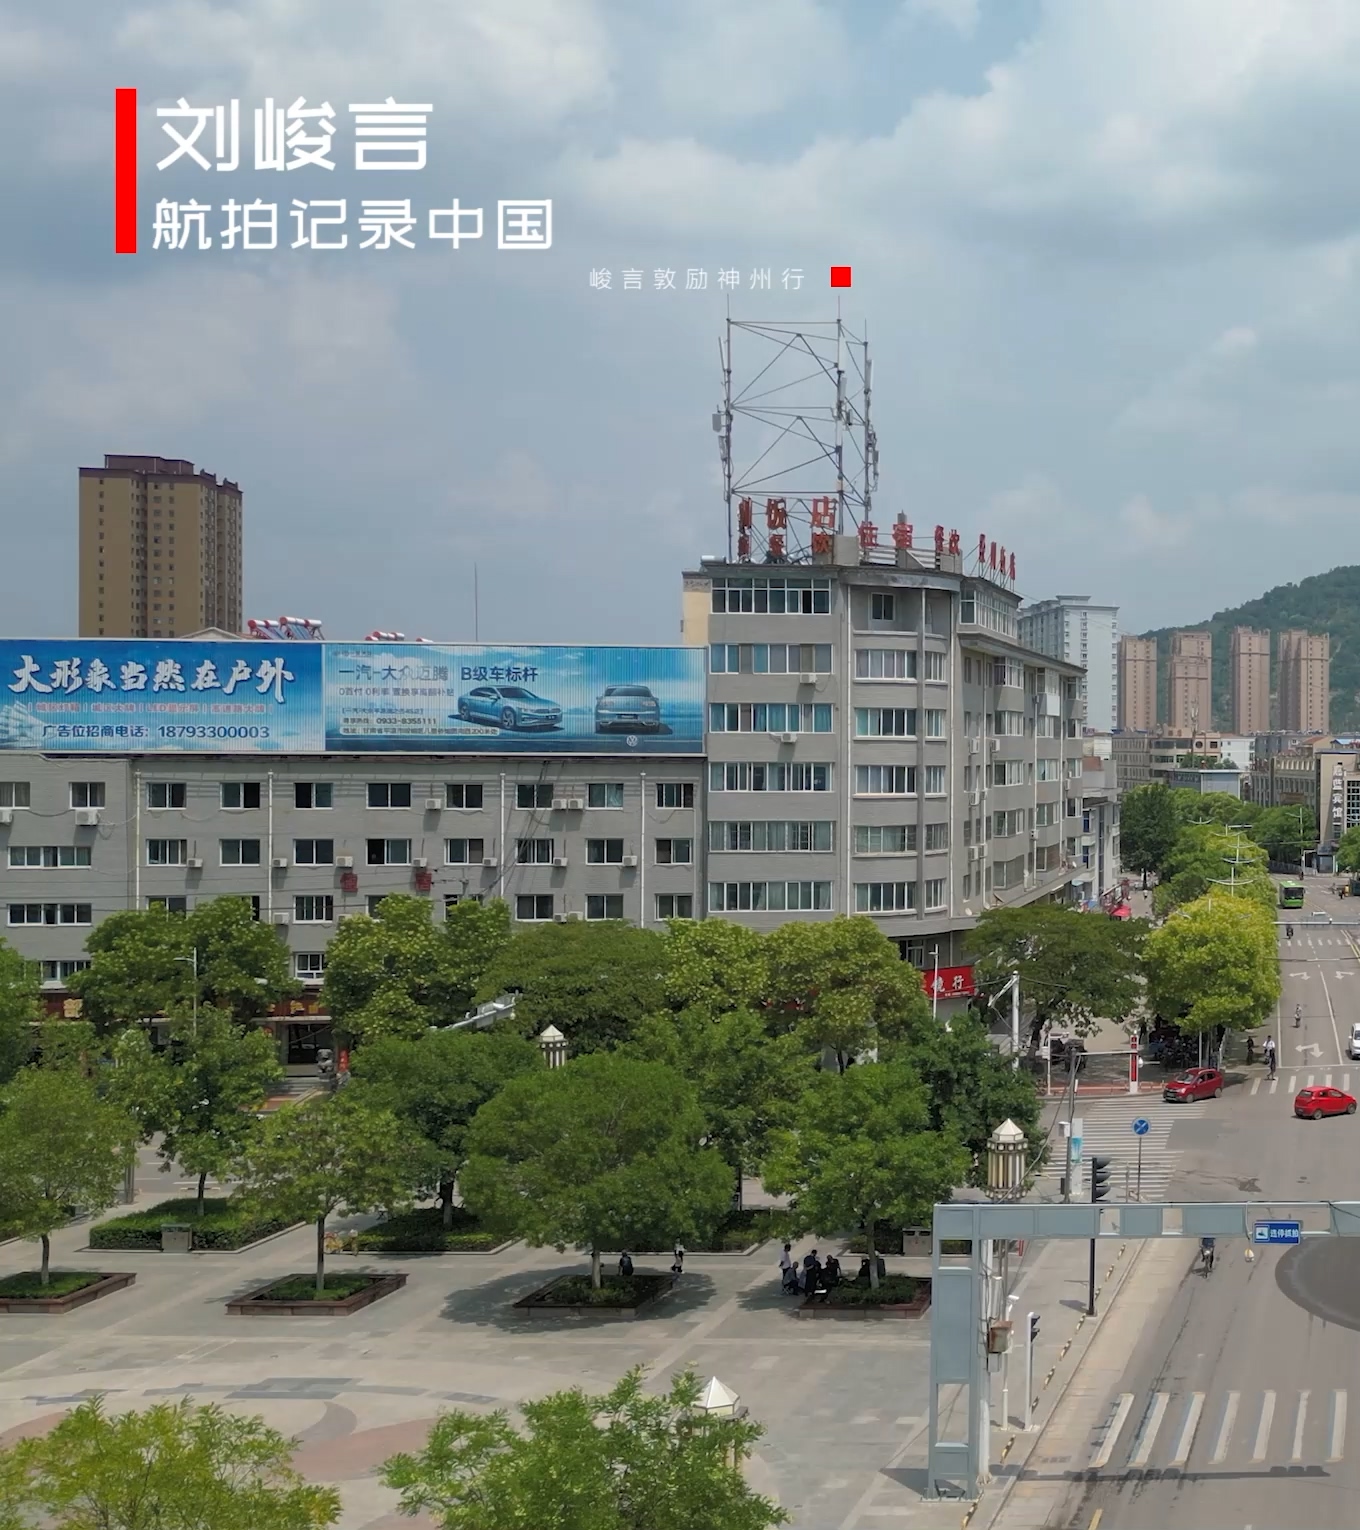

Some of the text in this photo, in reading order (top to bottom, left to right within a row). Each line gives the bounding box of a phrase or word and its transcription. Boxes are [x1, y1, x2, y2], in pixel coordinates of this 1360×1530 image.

[461, 667, 539, 682] B级车标杆
[158, 725, 270, 739] 18793300003
